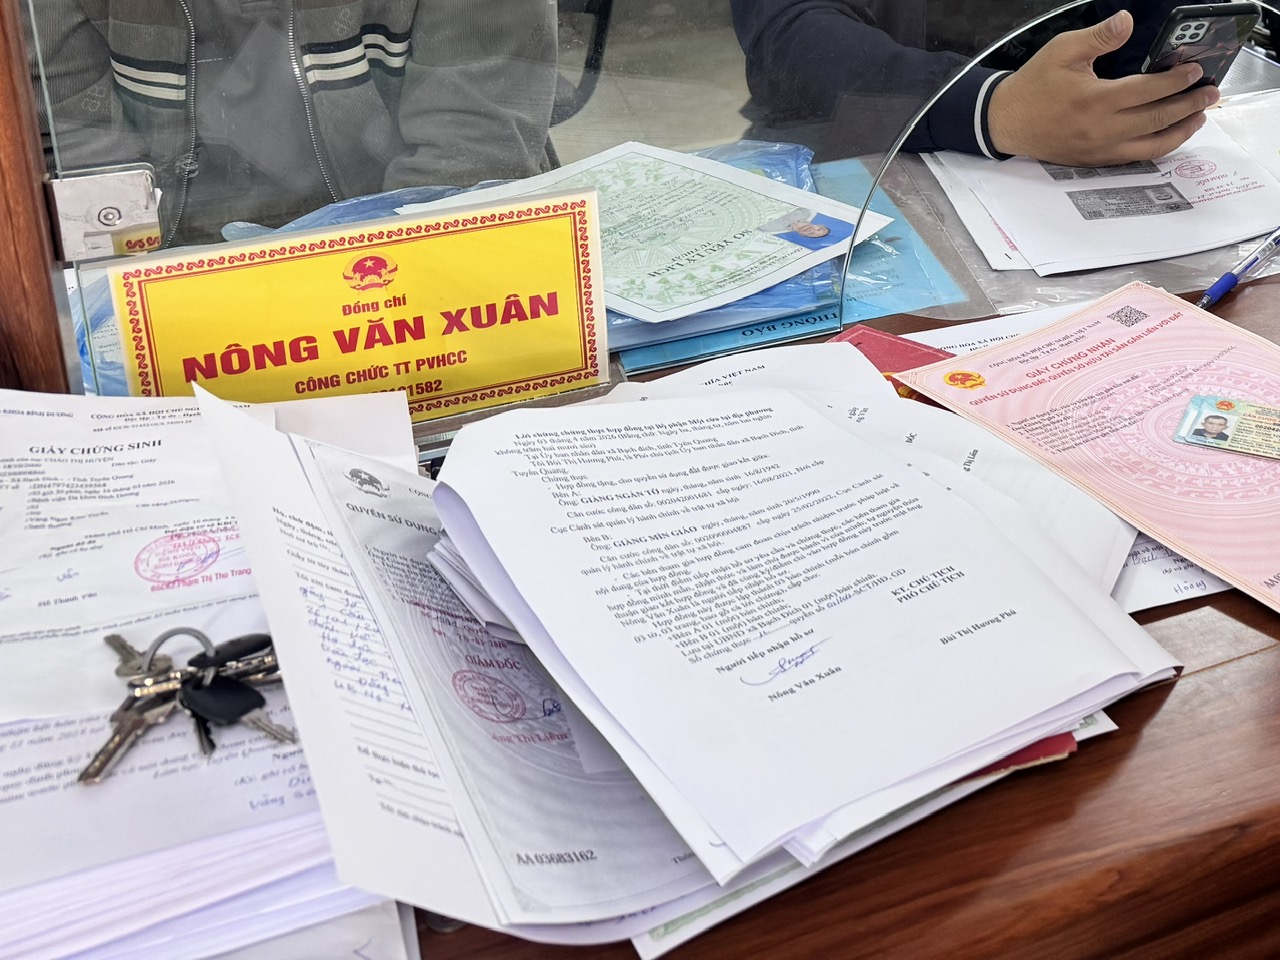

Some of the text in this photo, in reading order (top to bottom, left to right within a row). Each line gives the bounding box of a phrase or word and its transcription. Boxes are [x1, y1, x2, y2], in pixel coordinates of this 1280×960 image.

[342, 294, 407, 316] Đồng chí
[182, 291, 560, 383] NÔNG VĂN XUÂN
[295, 350, 468, 395] CÔNG CHỨC TT PVHCC
[29, 439, 162, 455] GIẤY CHỨNG SINH
